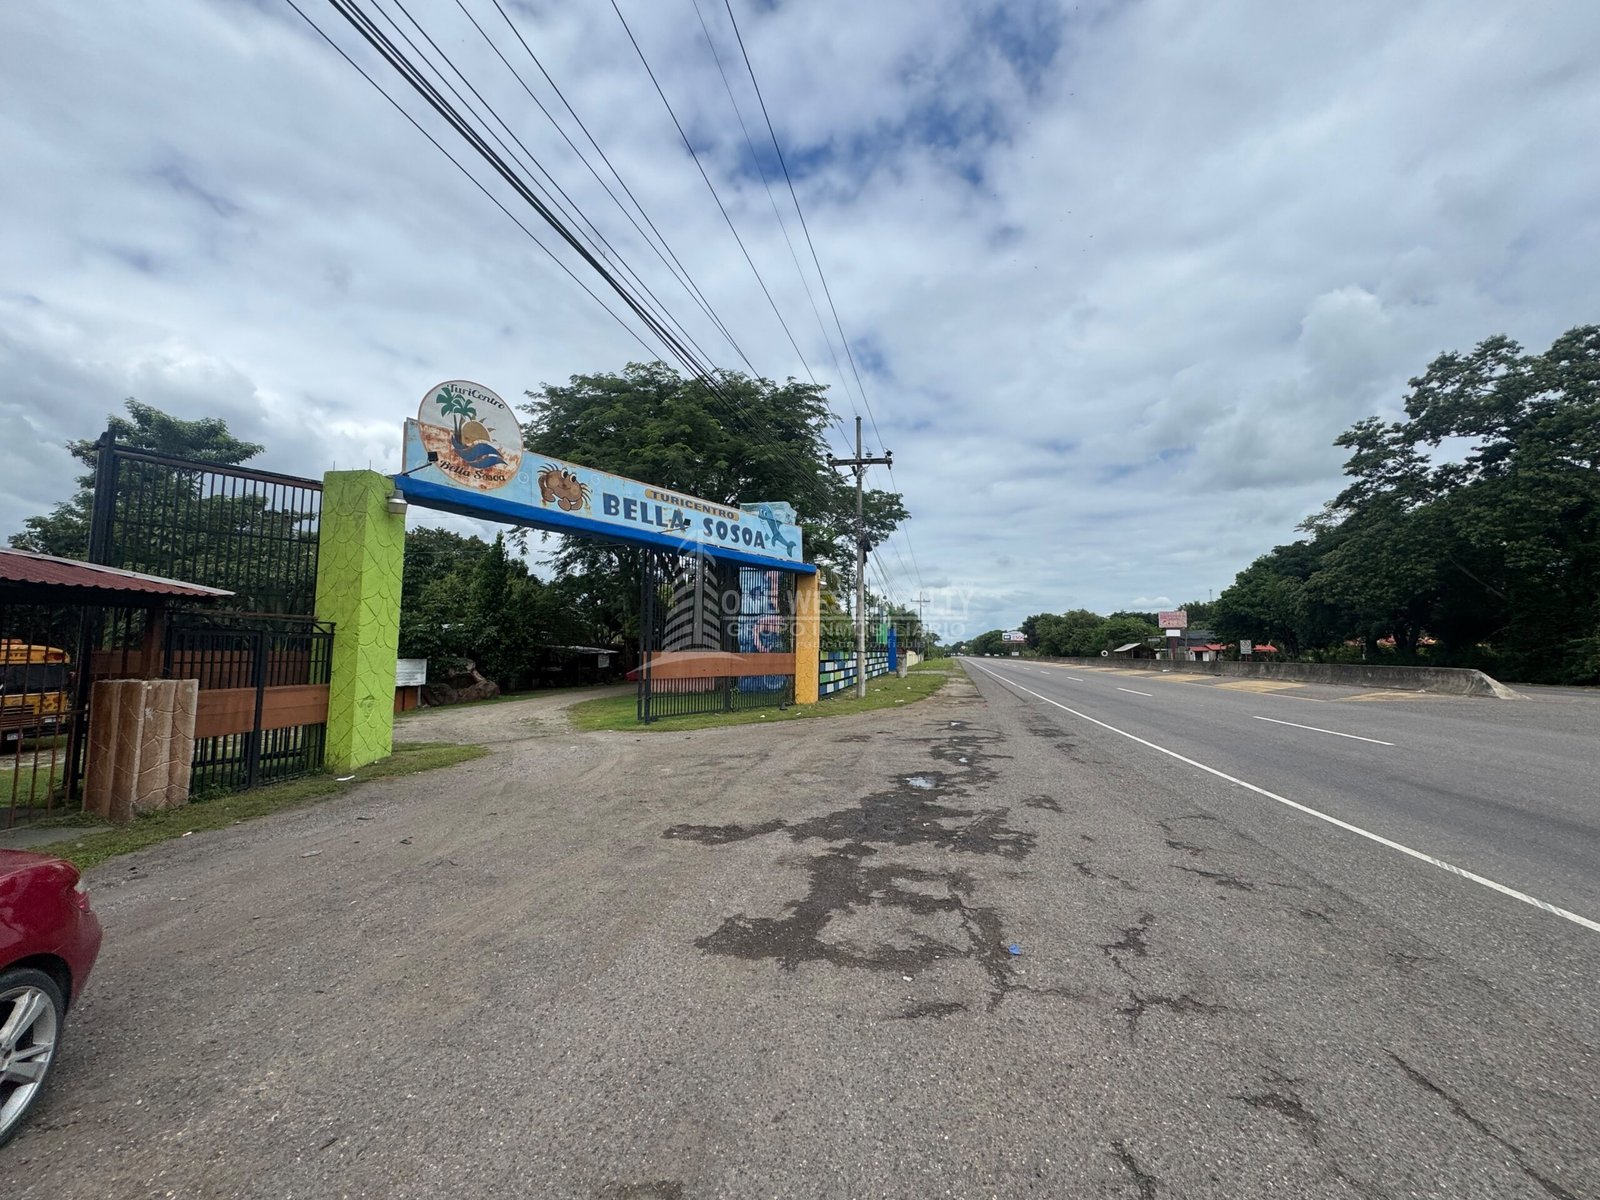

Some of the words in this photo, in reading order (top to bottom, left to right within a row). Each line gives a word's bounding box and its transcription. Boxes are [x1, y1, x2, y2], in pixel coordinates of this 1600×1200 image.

[440, 459, 471, 477] Bella
[650, 489, 735, 520] TURICENTRO
[602, 492, 685, 529] BELLA
[703, 517, 766, 549] SOSOA
